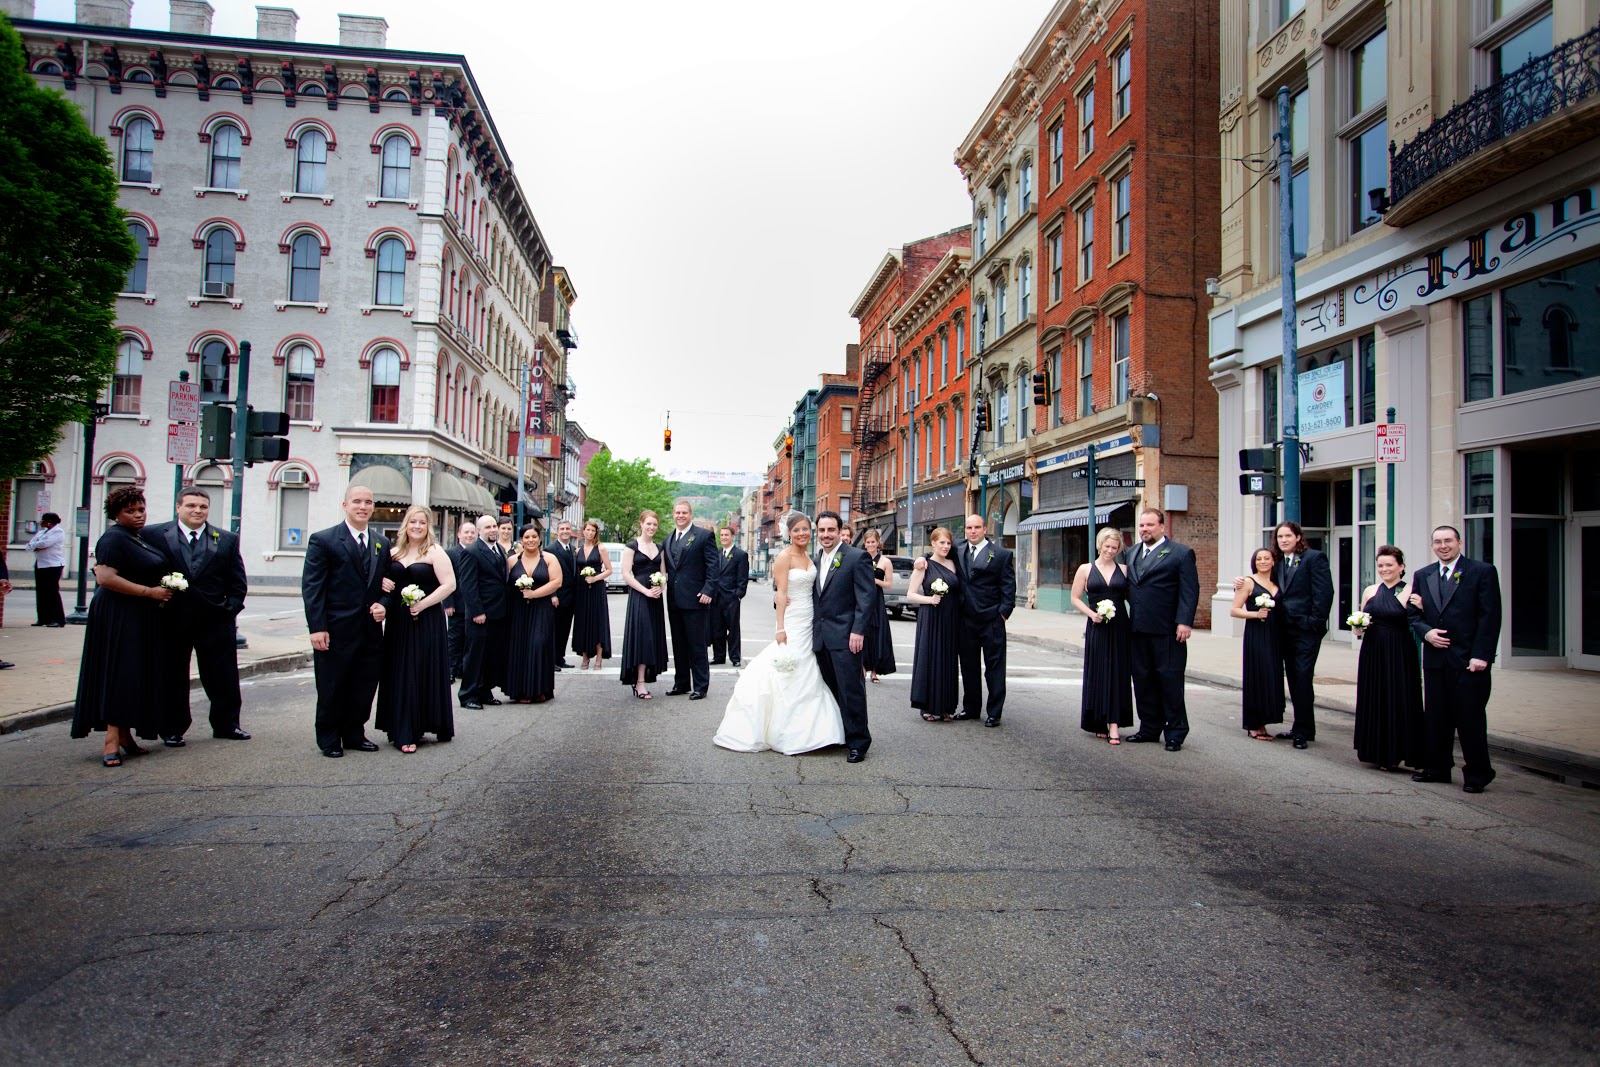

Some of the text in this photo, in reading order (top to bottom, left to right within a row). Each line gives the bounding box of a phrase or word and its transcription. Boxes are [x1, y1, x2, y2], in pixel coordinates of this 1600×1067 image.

[1371, 260, 1413, 291] THE
[1299, 373, 1310, 381] OFFICE
[1323, 366, 1331, 374] FOR
[1332, 362, 1343, 371] LEASE
[179, 384, 190, 392] NO
[529, 349, 543, 429] TOWER
[171, 391, 198, 402] PARKING
[1307, 400, 1333, 412] CAWDREY
[1301, 416, 1342, 431] 513-621-8600
[169, 425, 178, 434] NO
[1377, 427, 1386, 435] NO
[1383, 437, 1400, 446] ANY
[1383, 446, 1400, 455] TIME
